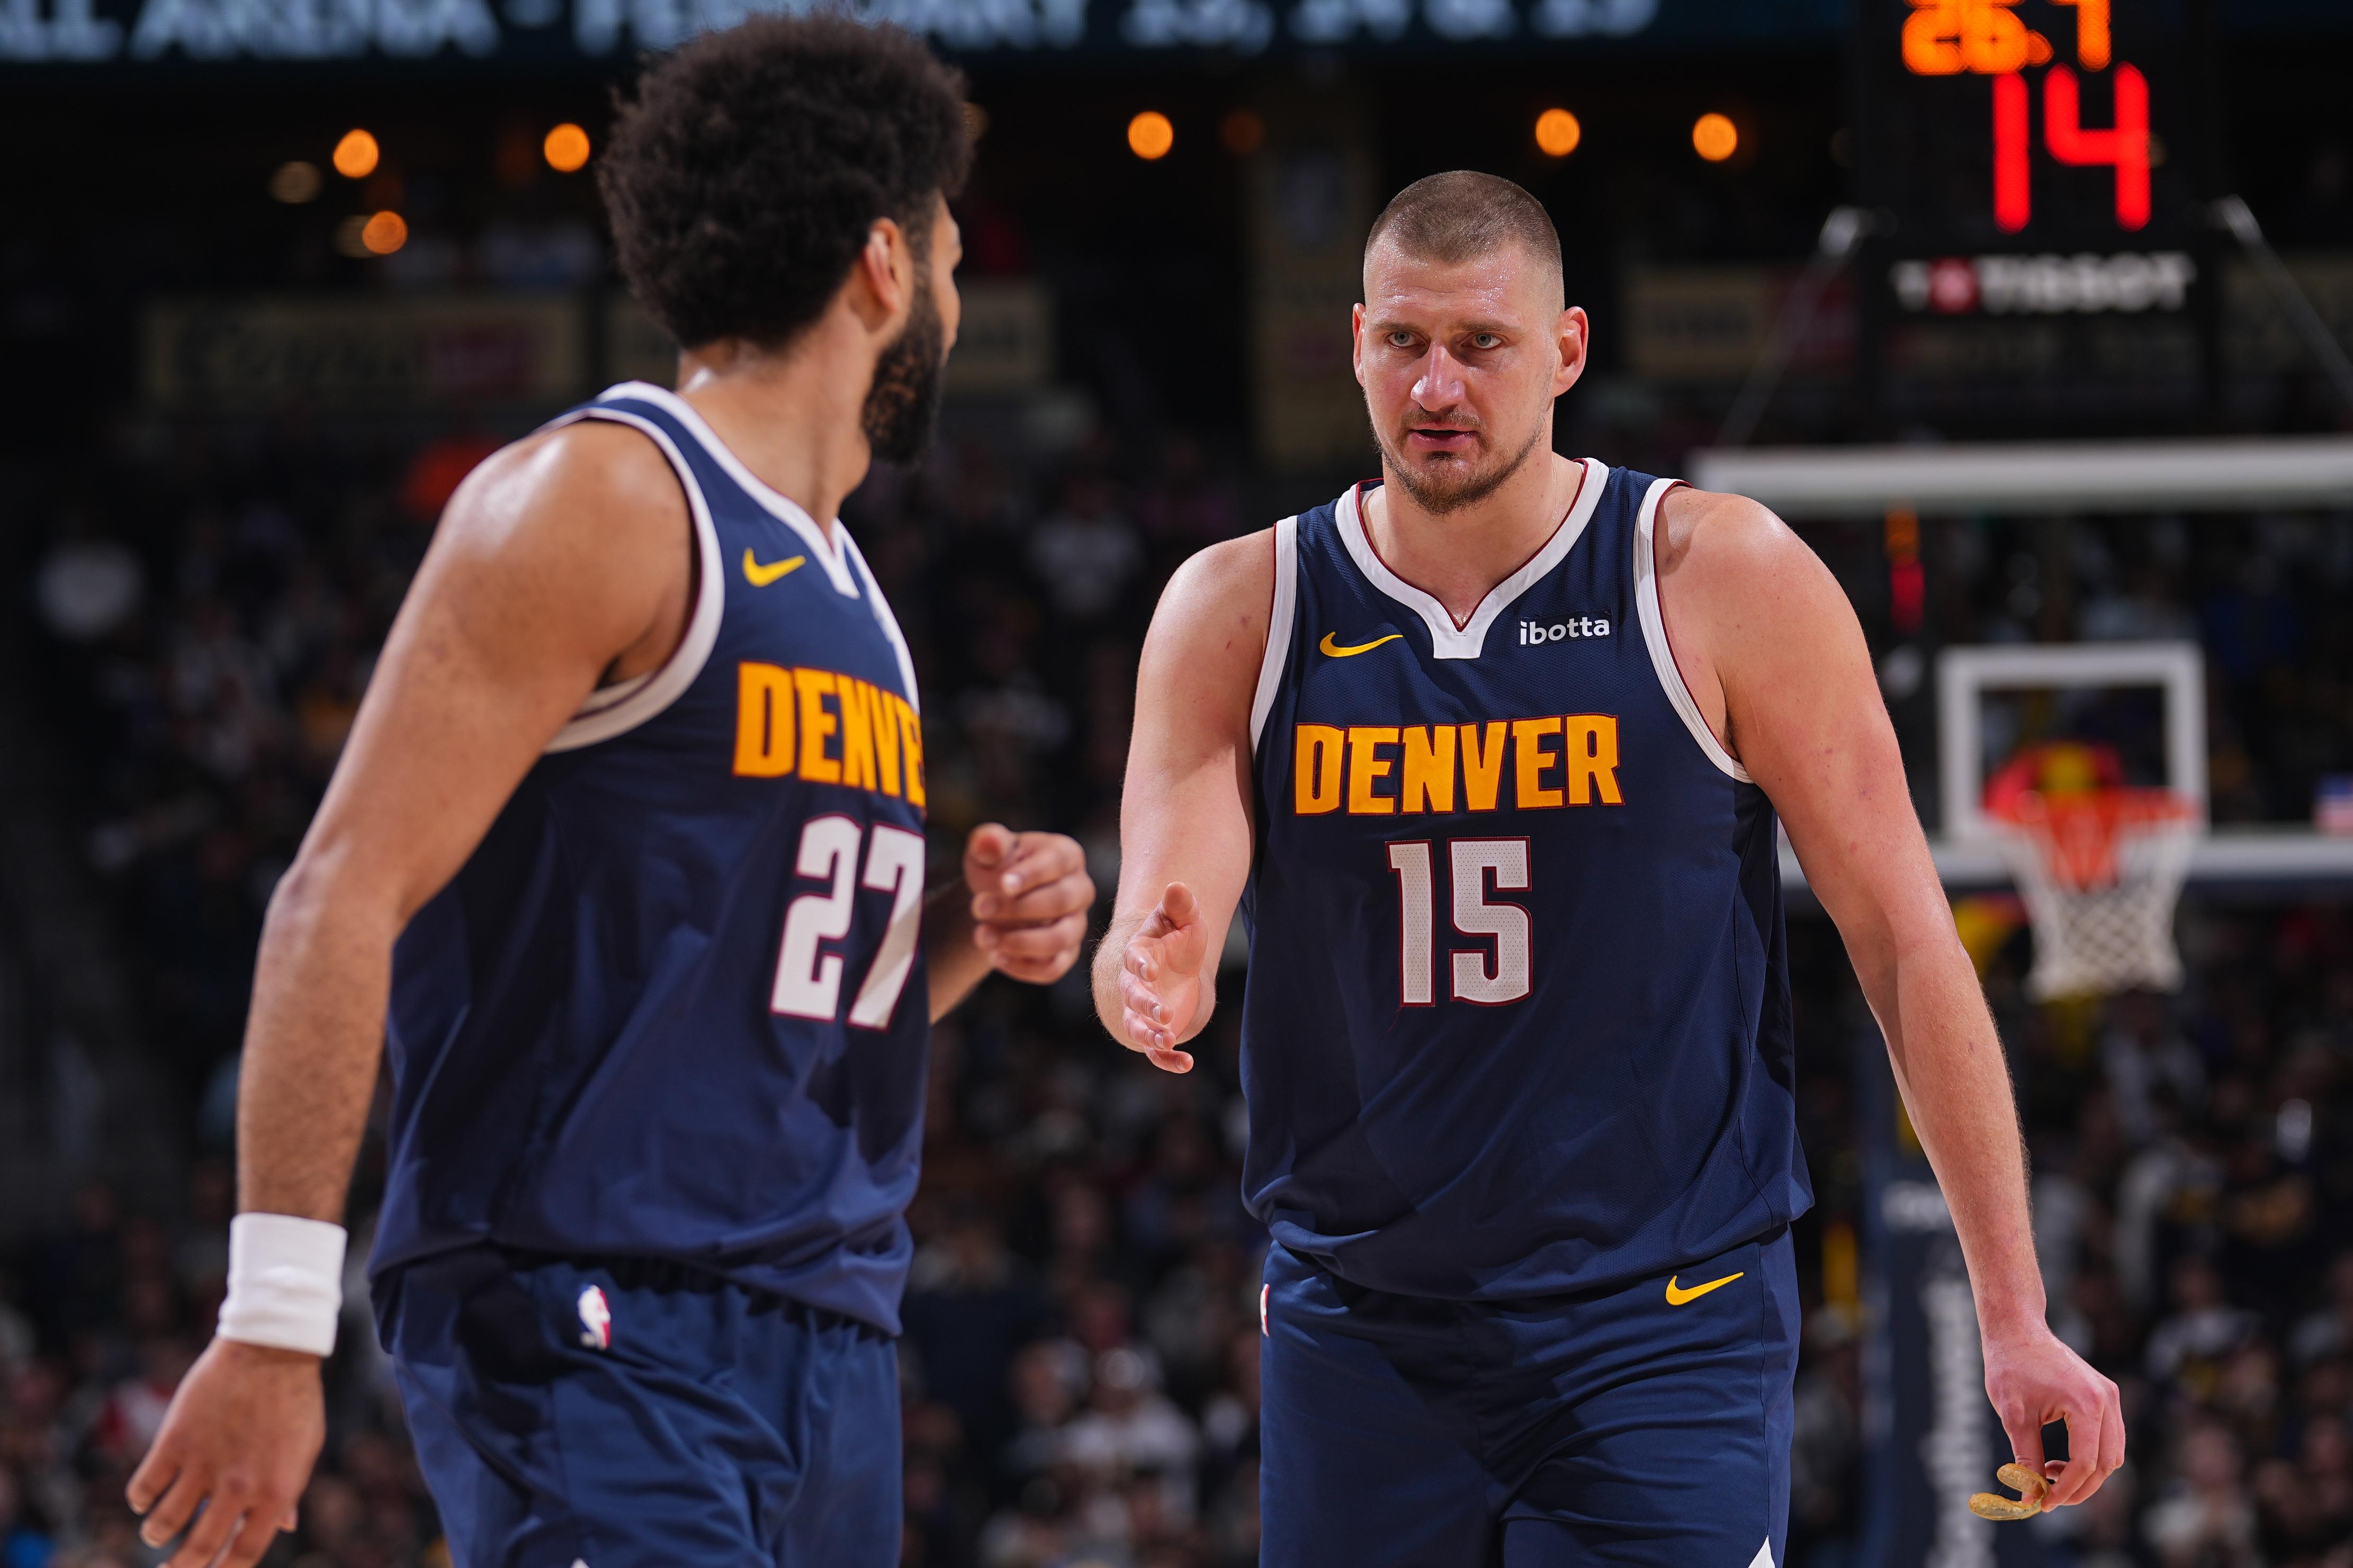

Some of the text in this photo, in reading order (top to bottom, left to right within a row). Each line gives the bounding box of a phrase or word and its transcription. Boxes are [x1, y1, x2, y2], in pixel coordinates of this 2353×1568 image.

[1992, 61, 2151, 233] 14
[1520, 617, 1611, 645] ibotta
[732, 661, 926, 808] DENVE
[1294, 713, 1625, 817] DENVER
[769, 812, 926, 1033] 27
[1385, 835, 1533, 1008] 15
